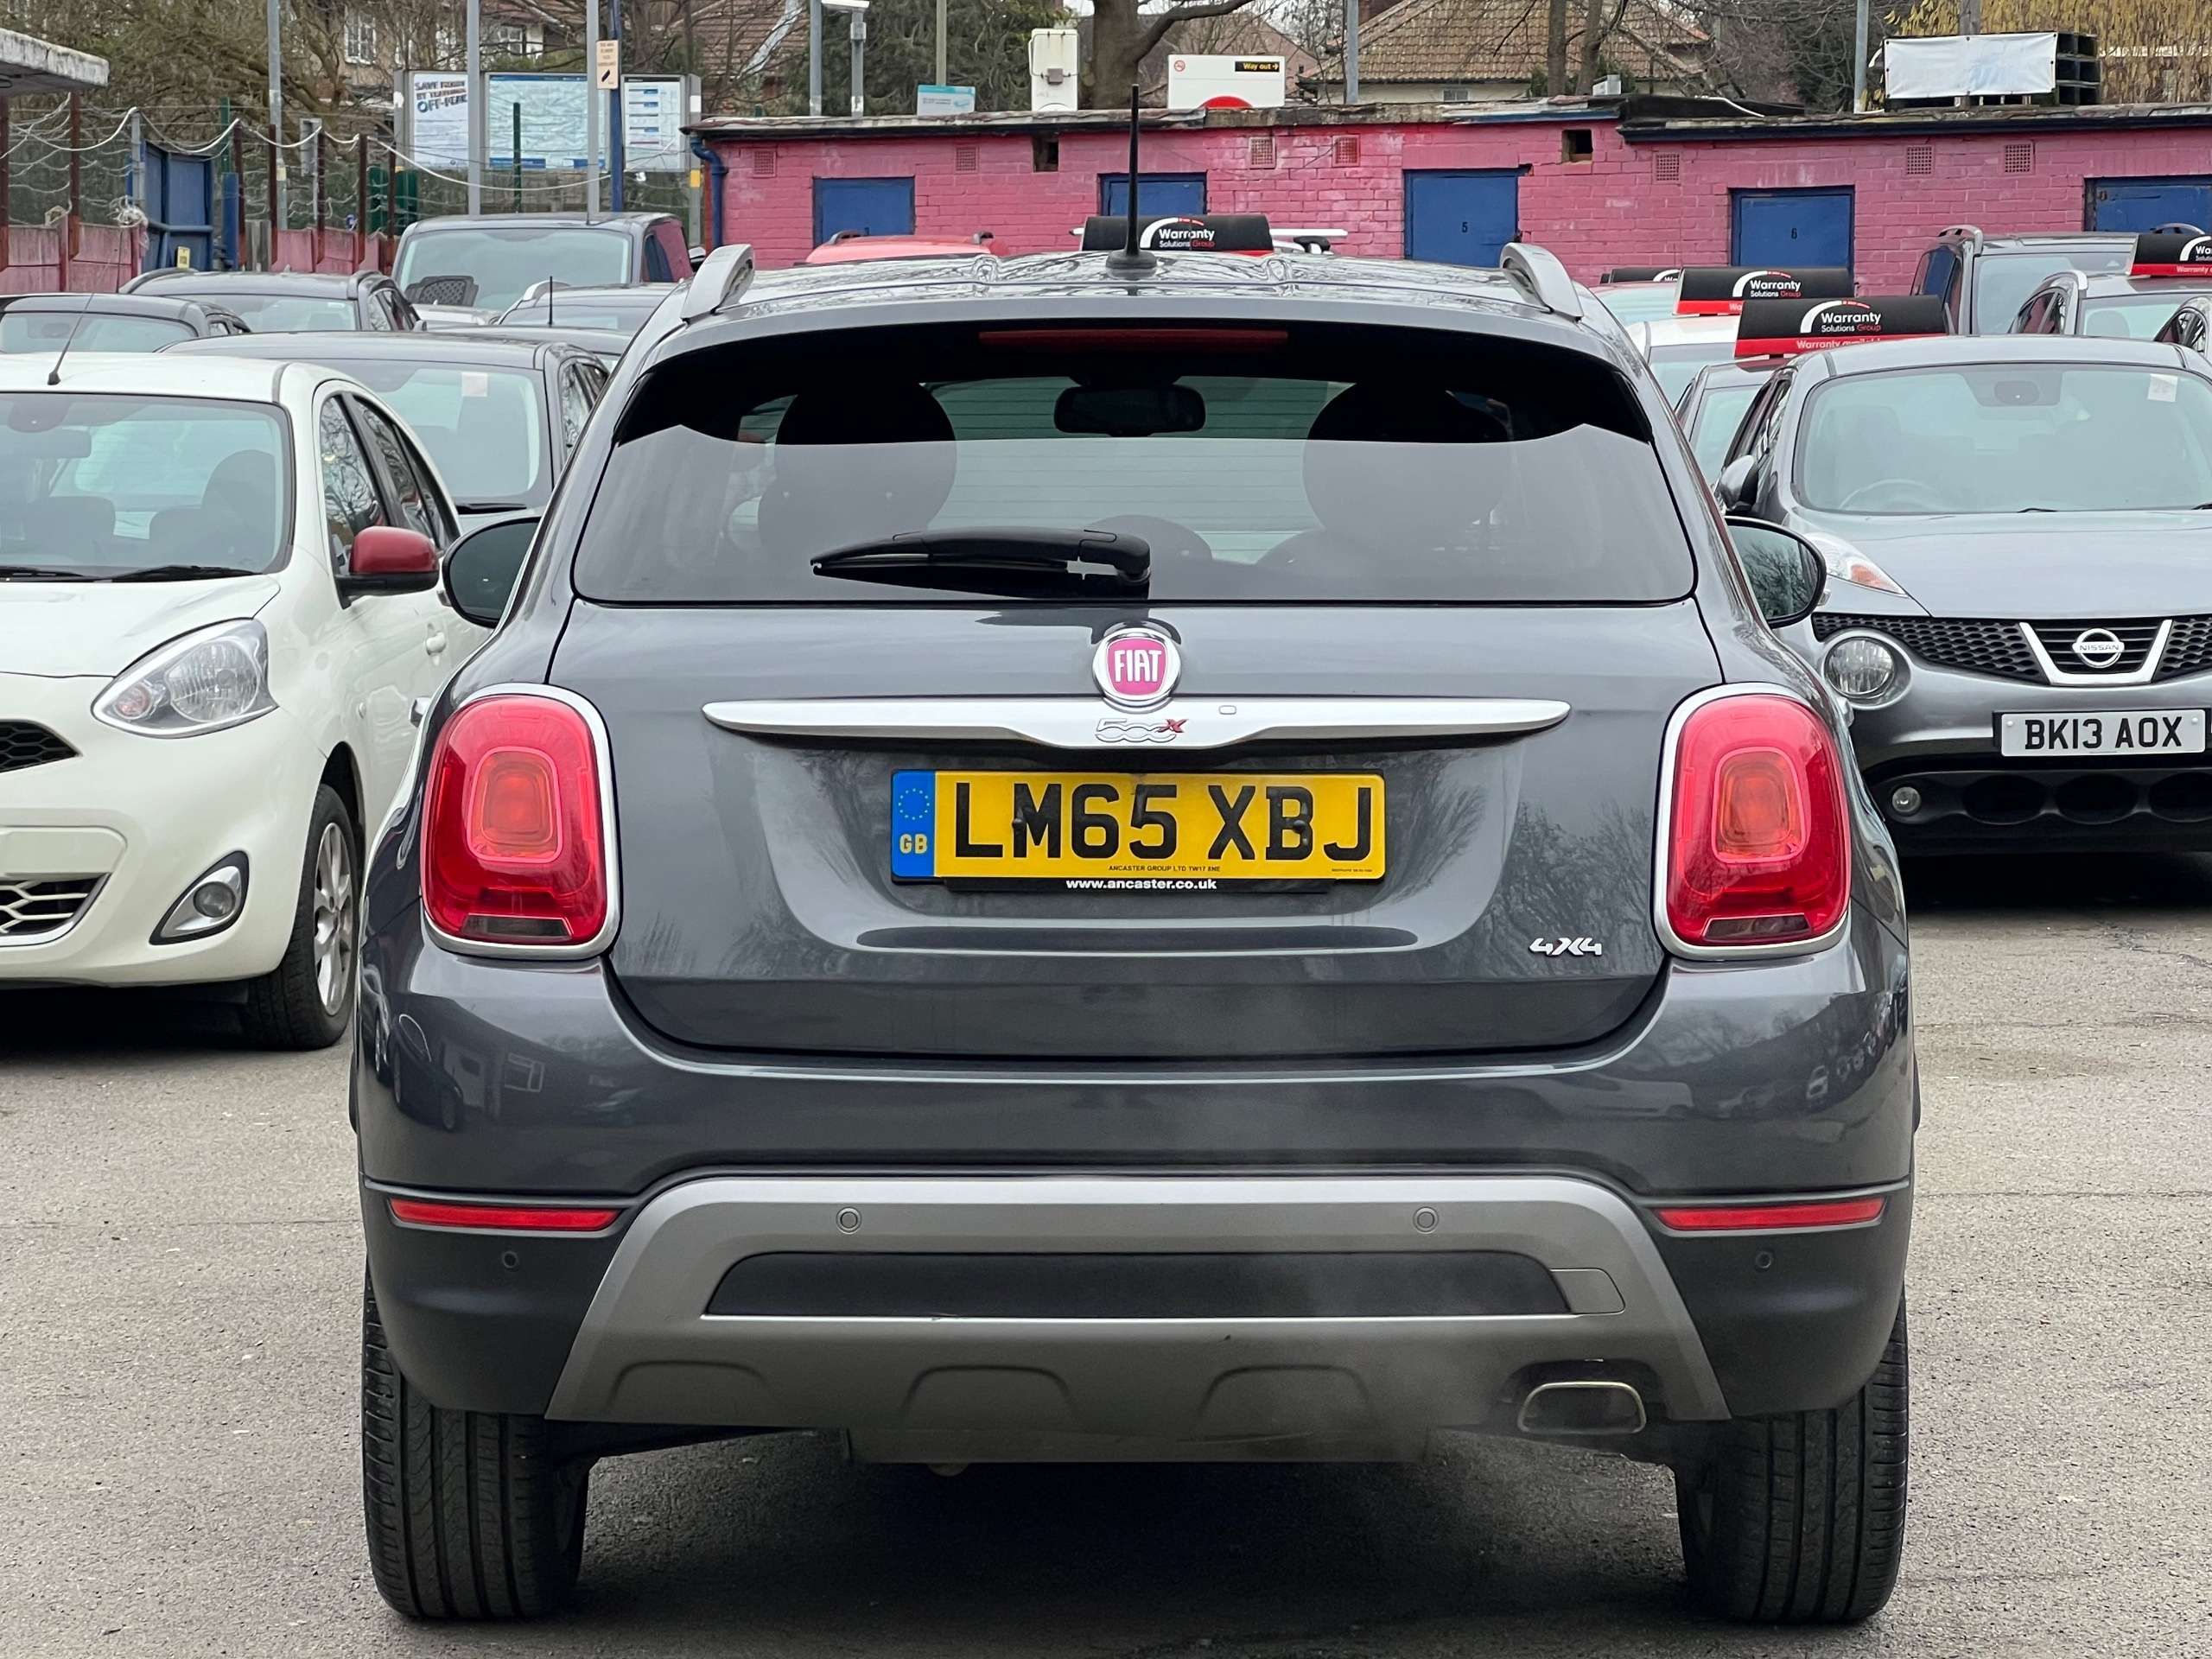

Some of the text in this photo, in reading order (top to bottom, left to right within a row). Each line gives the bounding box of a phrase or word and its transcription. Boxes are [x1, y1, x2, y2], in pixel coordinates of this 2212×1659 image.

[1462, 221, 1468, 232] 5
[1159, 229, 1215, 241] Warranty
[1791, 227, 1798, 239] 6
[1192, 240, 1216, 249] Group
[1750, 280, 1802, 291] Warranty
[1821, 312, 1881, 324] Warranty
[1821, 324, 1855, 333] Solutions
[1796, 340, 1841, 349] Warranty
[1114, 650, 1162, 682] FIAT
[2024, 716, 2183, 750] BK13 AOX
[955, 782, 1371, 861] LM65 XBJ
[899, 834, 927, 854] GB
[1065, 879, 1217, 890] www.ancaster.co.uk
